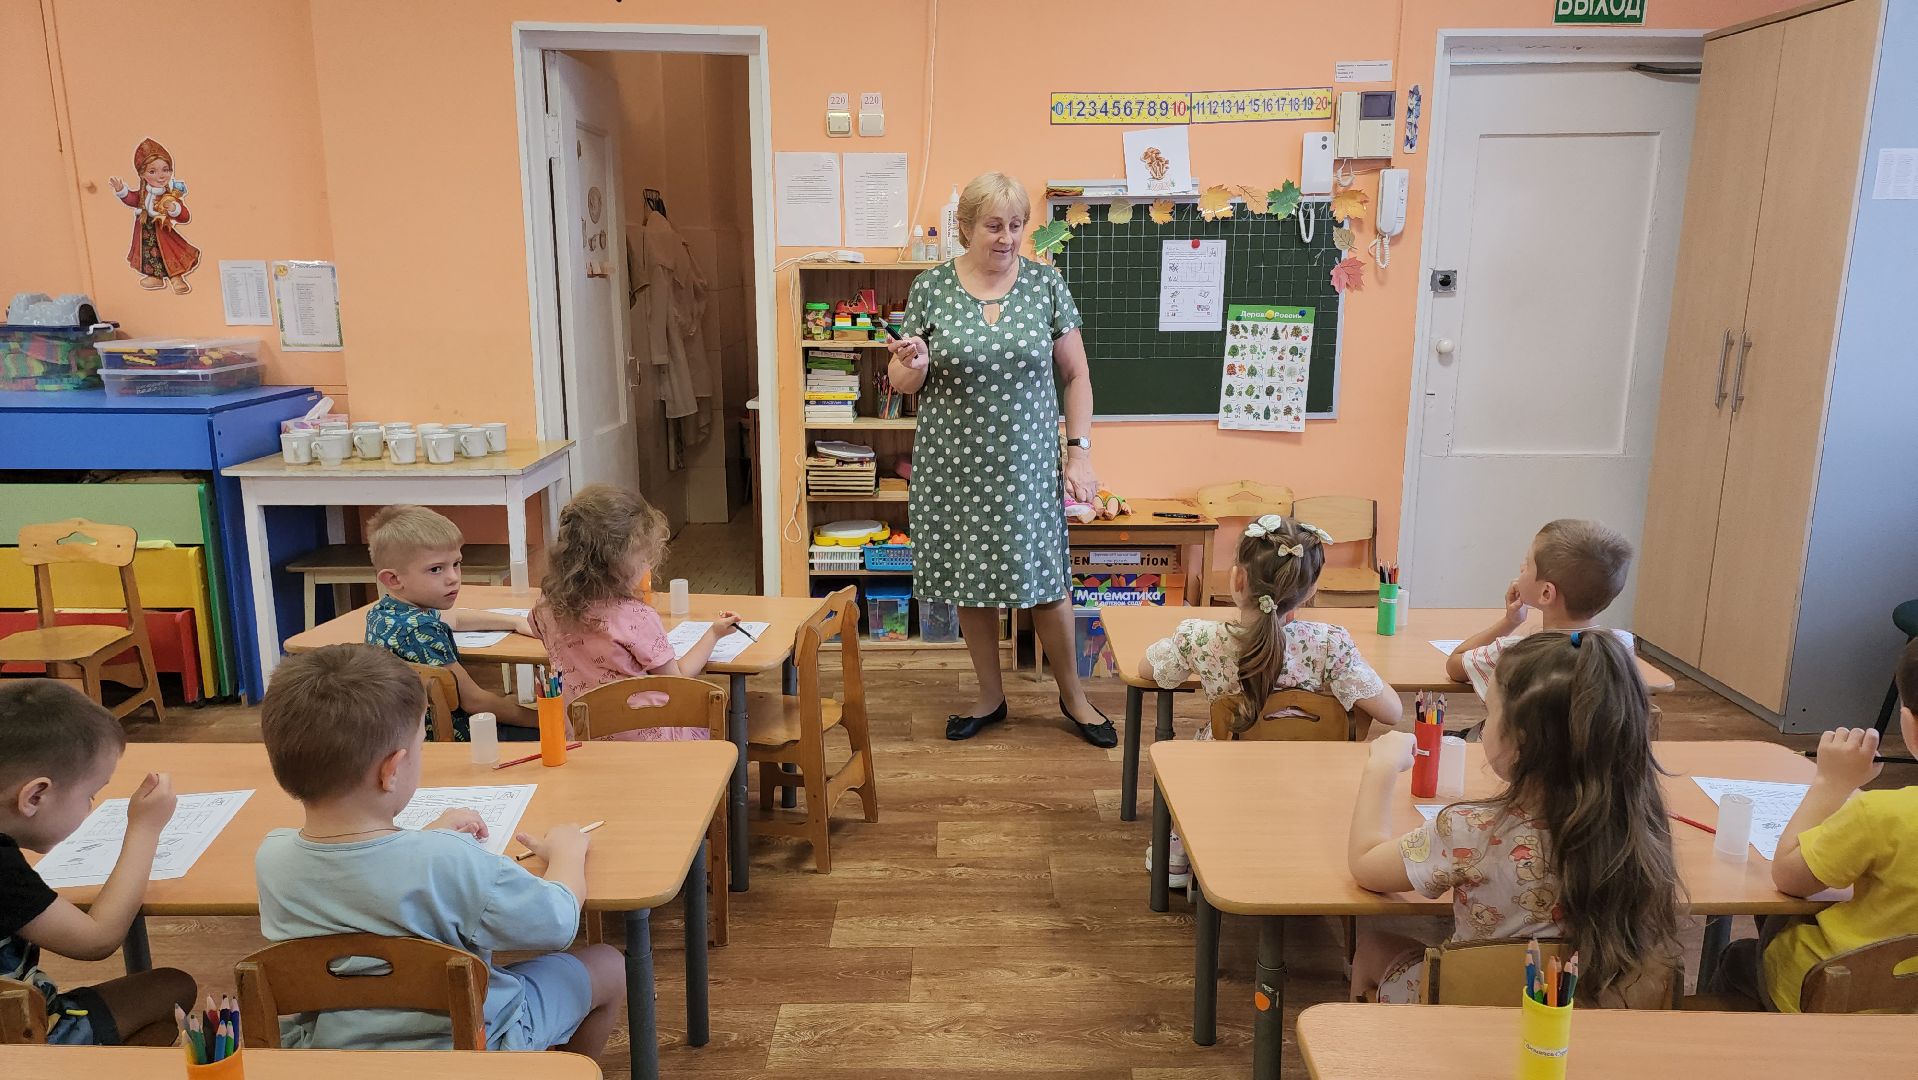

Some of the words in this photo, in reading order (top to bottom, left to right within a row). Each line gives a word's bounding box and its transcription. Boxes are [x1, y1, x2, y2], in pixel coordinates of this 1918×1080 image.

[830, 96, 846, 105] 220
[864, 96, 879, 105] 220
[1195, 101, 1206, 115] 11
[1207, 100, 1219, 115] 12
[1220, 99, 1232, 114] 13
[1234, 99, 1246, 114] 14
[1248, 98, 1260, 113] 15
[1261, 98, 1273, 113] 16
[1275, 97, 1287, 112] 17
[1288, 97, 1300, 112] 18
[1301, 96, 1314, 111] 19
[1315, 96, 1328, 111] 20
[1055, 102, 1064, 116] 0
[1066, 100, 1073, 117] 1
[1076, 100, 1086, 117] 2
[1088, 100, 1097, 117] 3
[1099, 100, 1109, 117] 4
[1112, 100, 1121, 117] 5
[1123, 100, 1133, 117] 6
[1135, 100, 1145, 117] 7
[1147, 100, 1157, 117] 8
[1159, 100, 1169, 117] 9
[1170, 100, 1187, 116] 10
[1076, 589, 1162, 601] Математика
